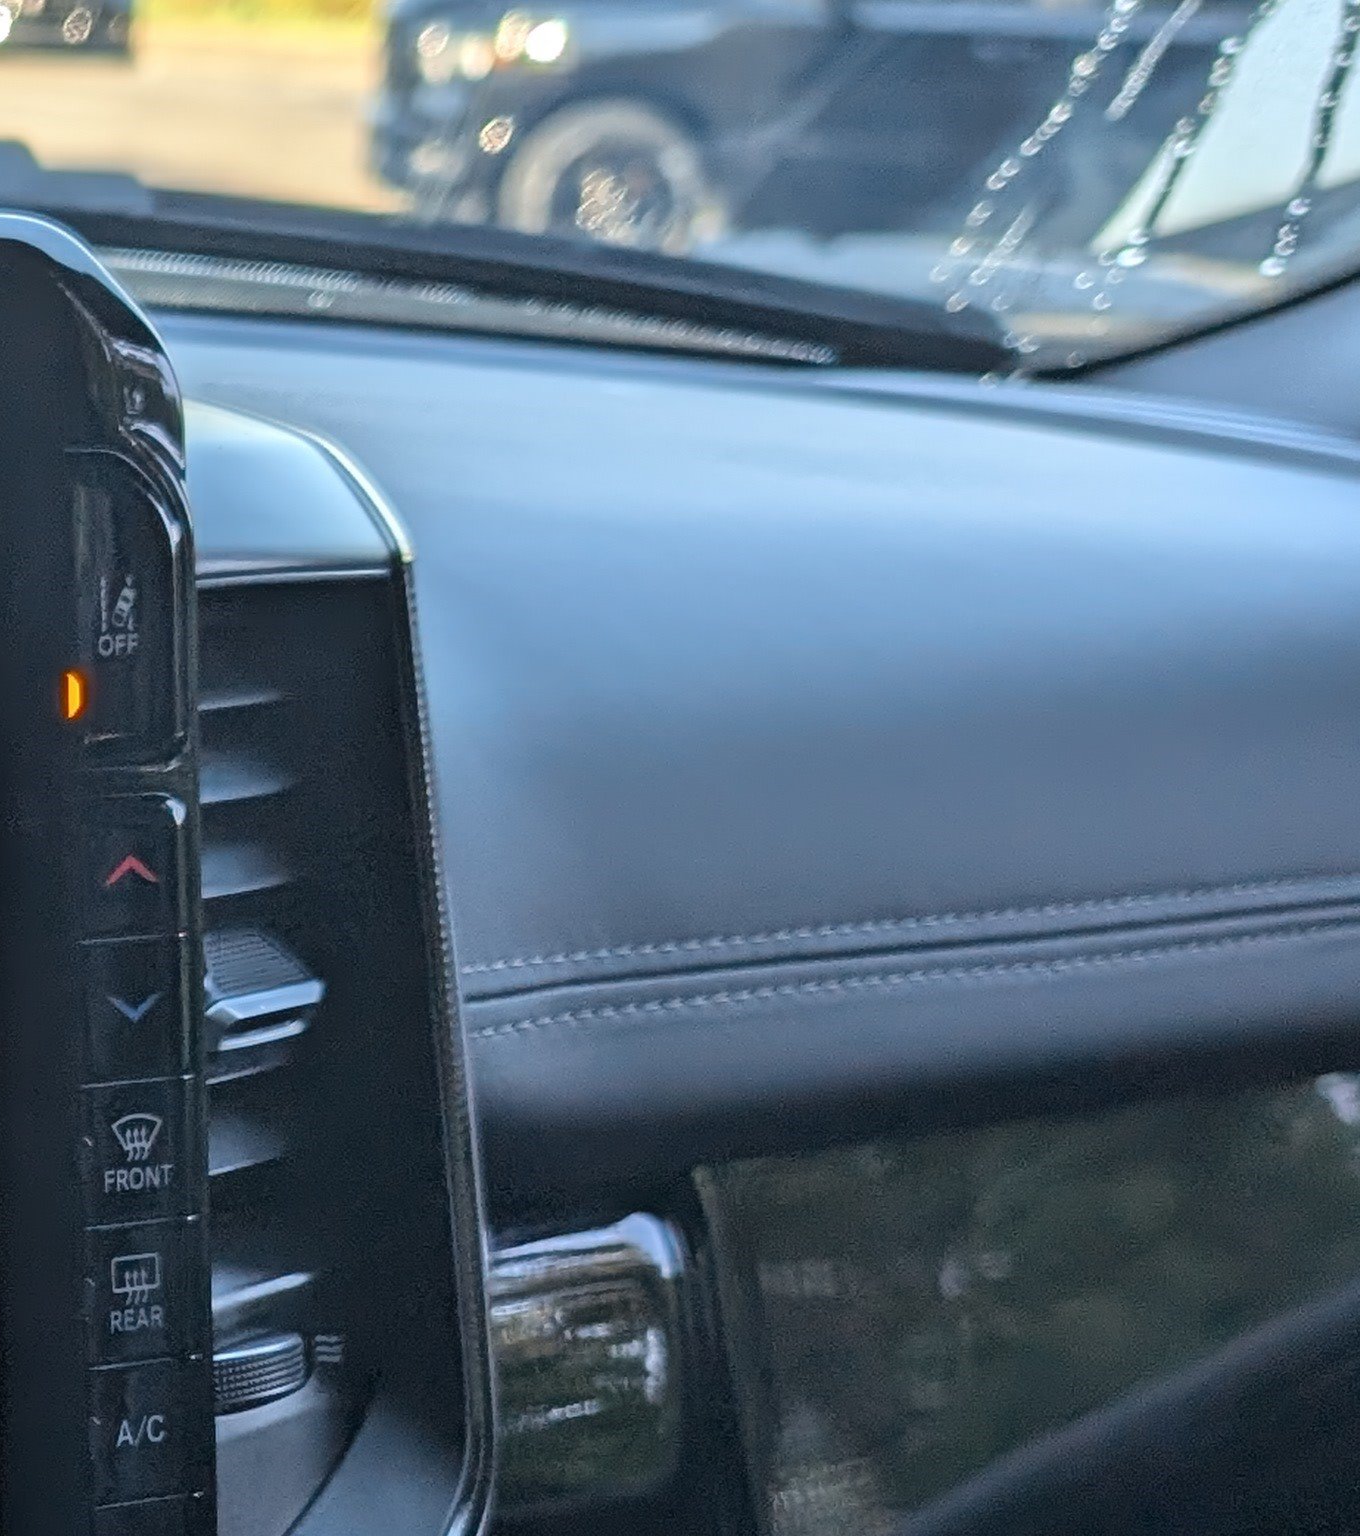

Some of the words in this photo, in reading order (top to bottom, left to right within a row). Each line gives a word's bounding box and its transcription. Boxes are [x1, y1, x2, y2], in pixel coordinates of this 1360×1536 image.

[98, 634, 139, 656] OFF
[103, 1162, 173, 1193] FRONT
[109, 1305, 164, 1333] REAR
[116, 1414, 167, 1449] A/C
